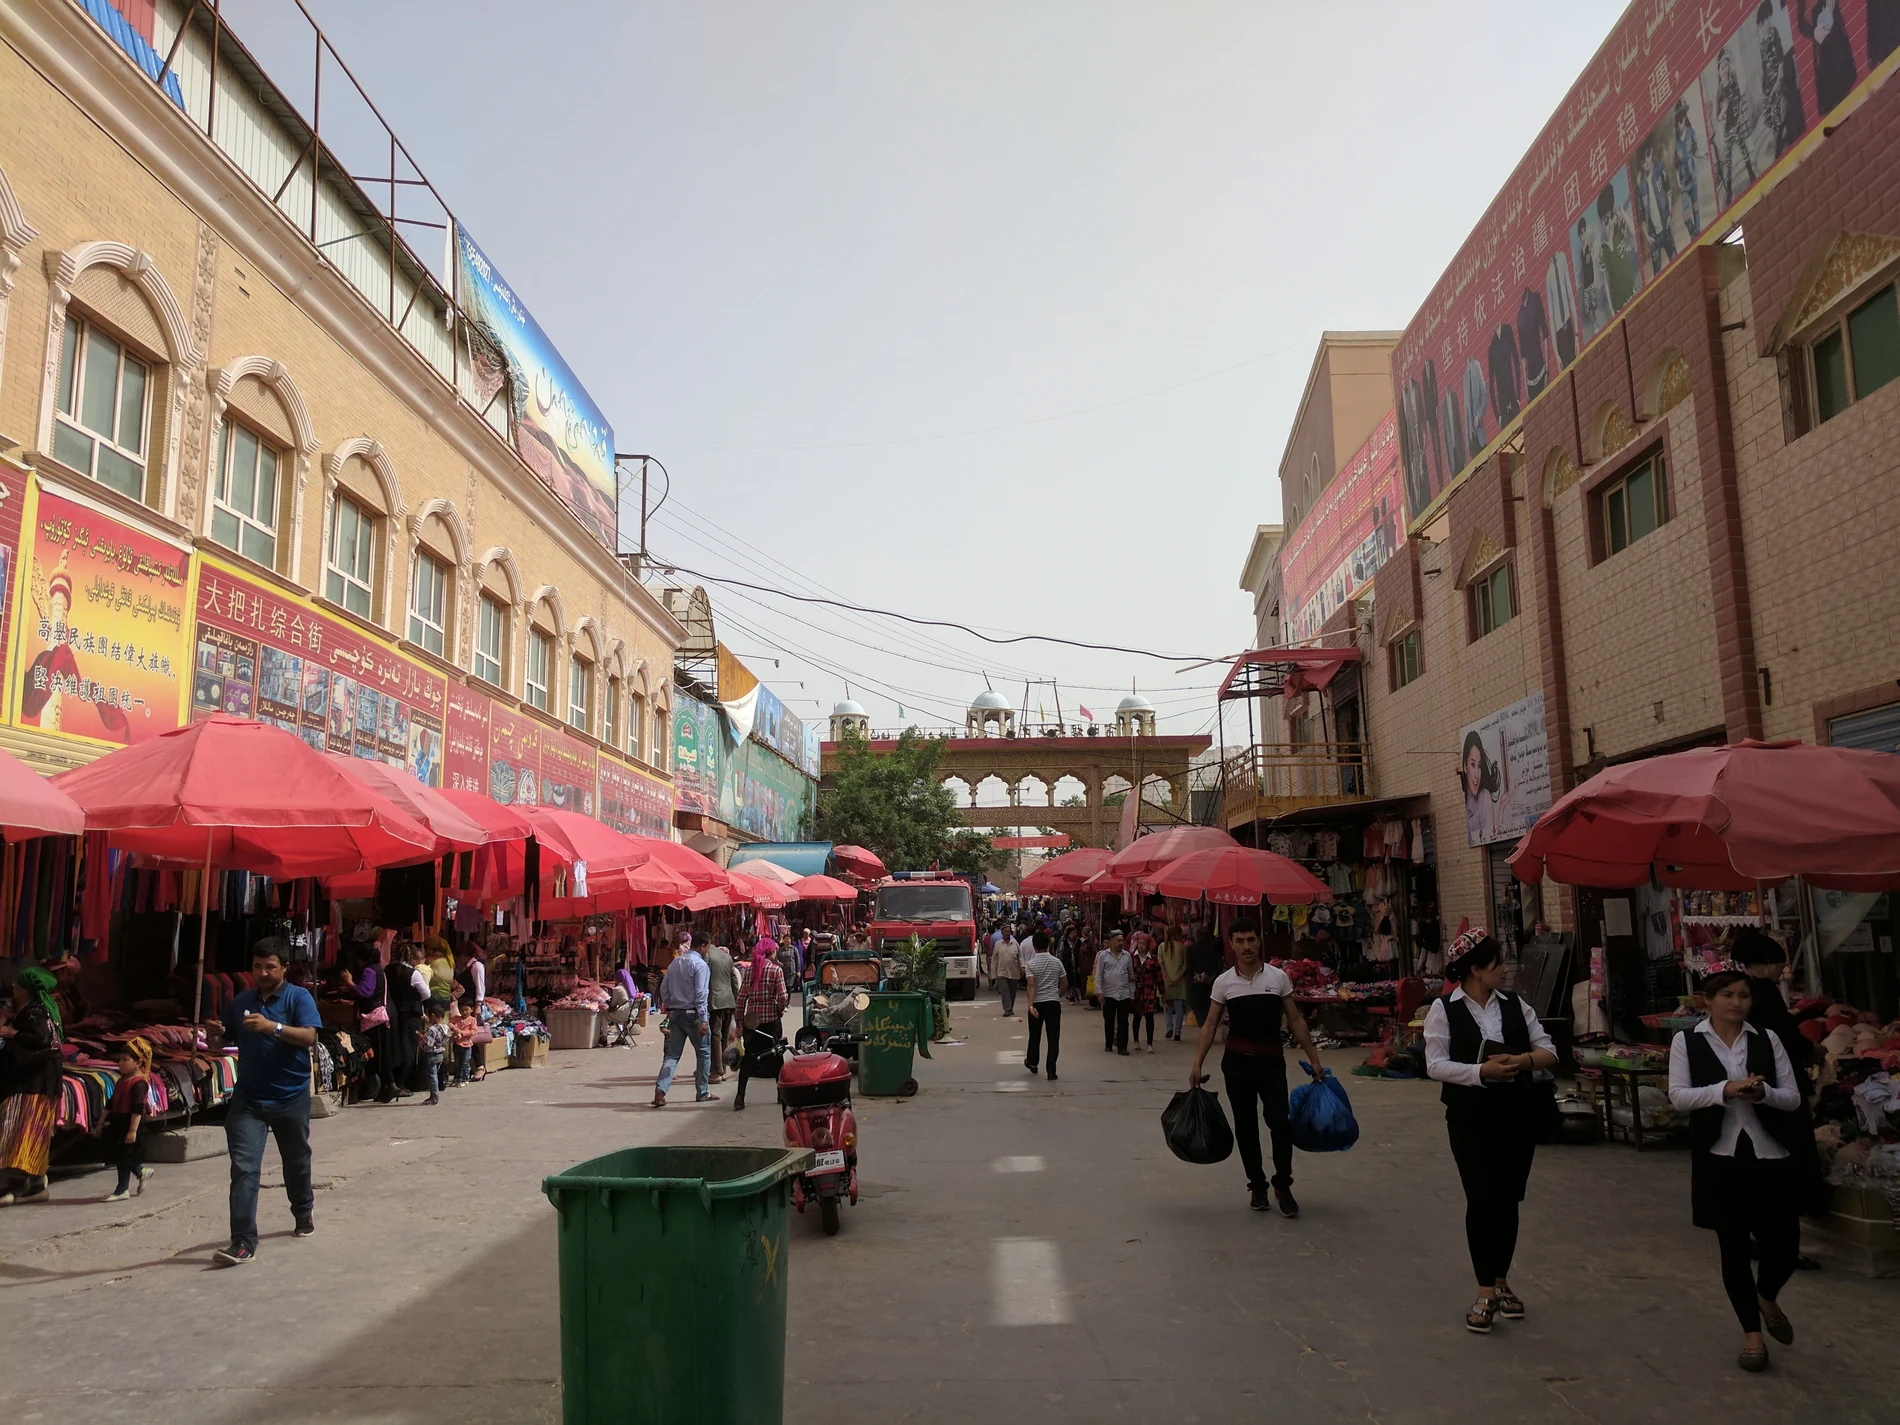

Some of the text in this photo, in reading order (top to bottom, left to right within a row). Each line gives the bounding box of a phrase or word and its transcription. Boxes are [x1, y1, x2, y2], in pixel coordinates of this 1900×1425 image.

[1614, 27, 1638, 94] بىلەن
[203, 578, 323, 654] 大把扎综合街
[402, 667, 422, 697] بازار
